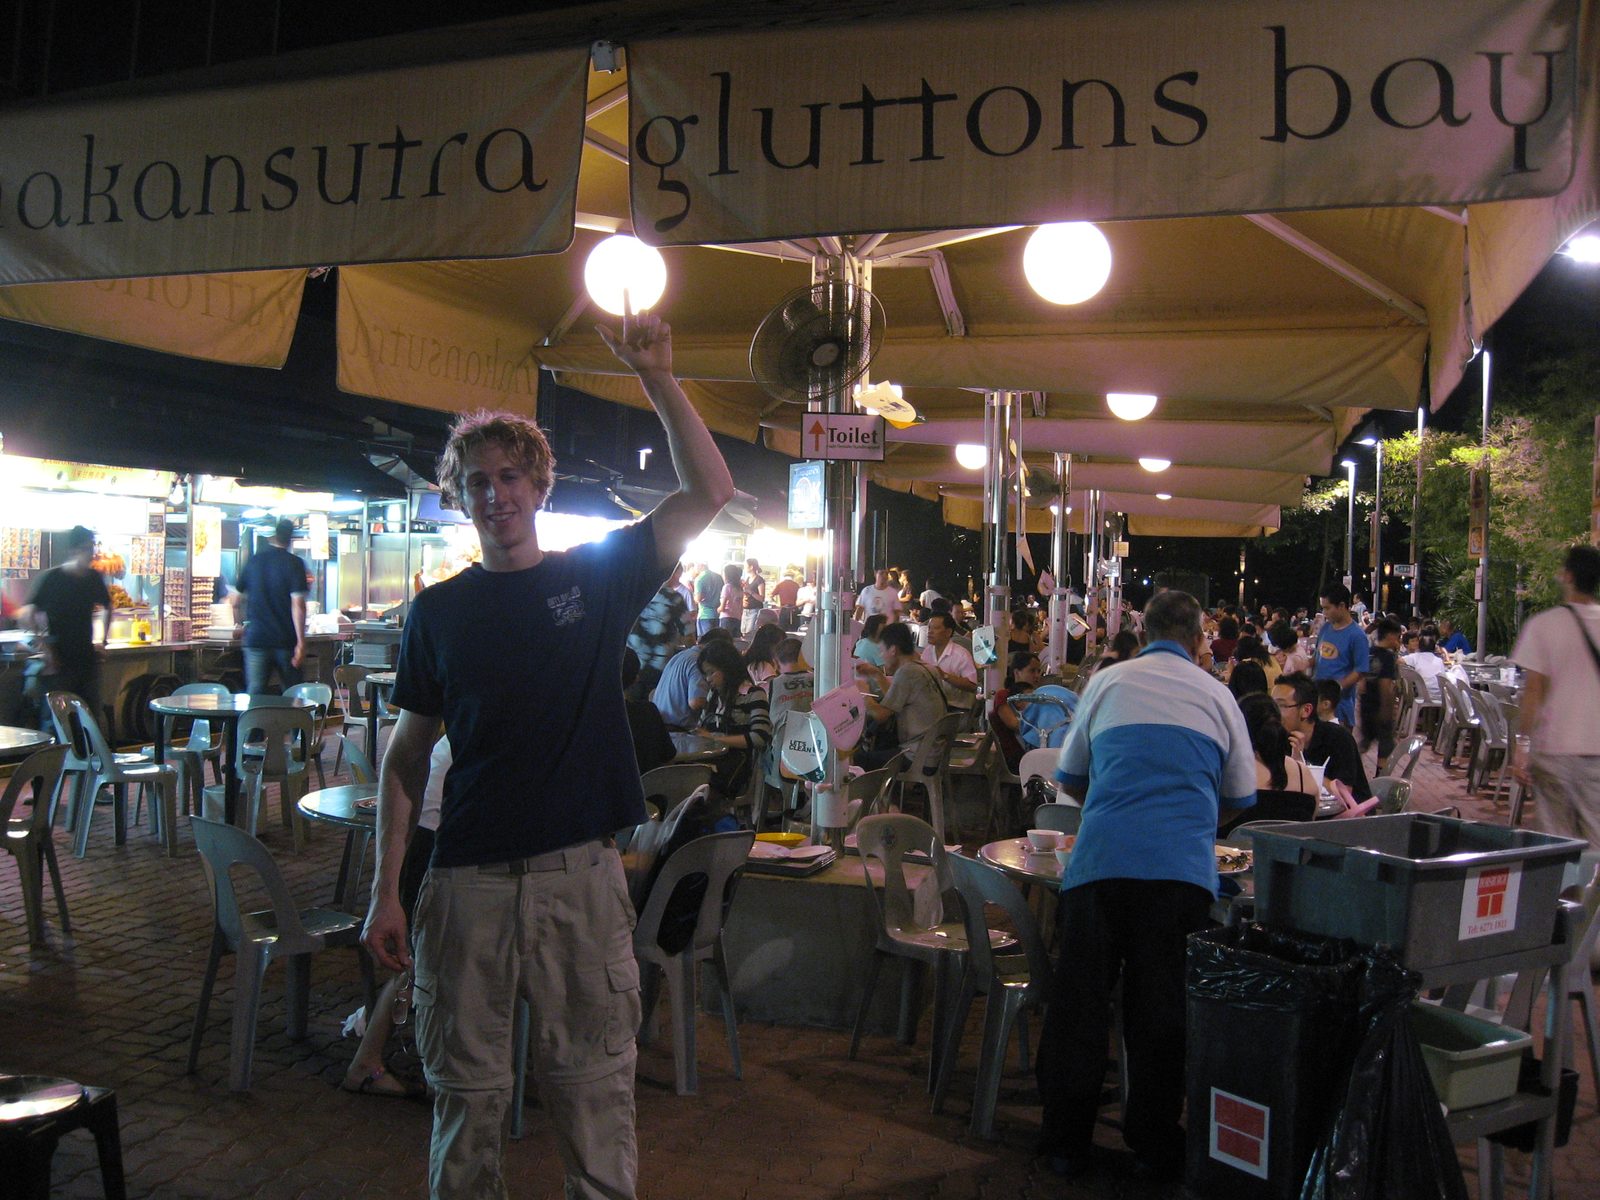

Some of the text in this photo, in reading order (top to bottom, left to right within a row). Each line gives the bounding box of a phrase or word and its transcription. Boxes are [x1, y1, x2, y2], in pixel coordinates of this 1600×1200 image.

[0, 125, 547, 230] akansutra
[636, 26, 1566, 232] gluttons bay
[827, 427, 878, 444] Toilet
